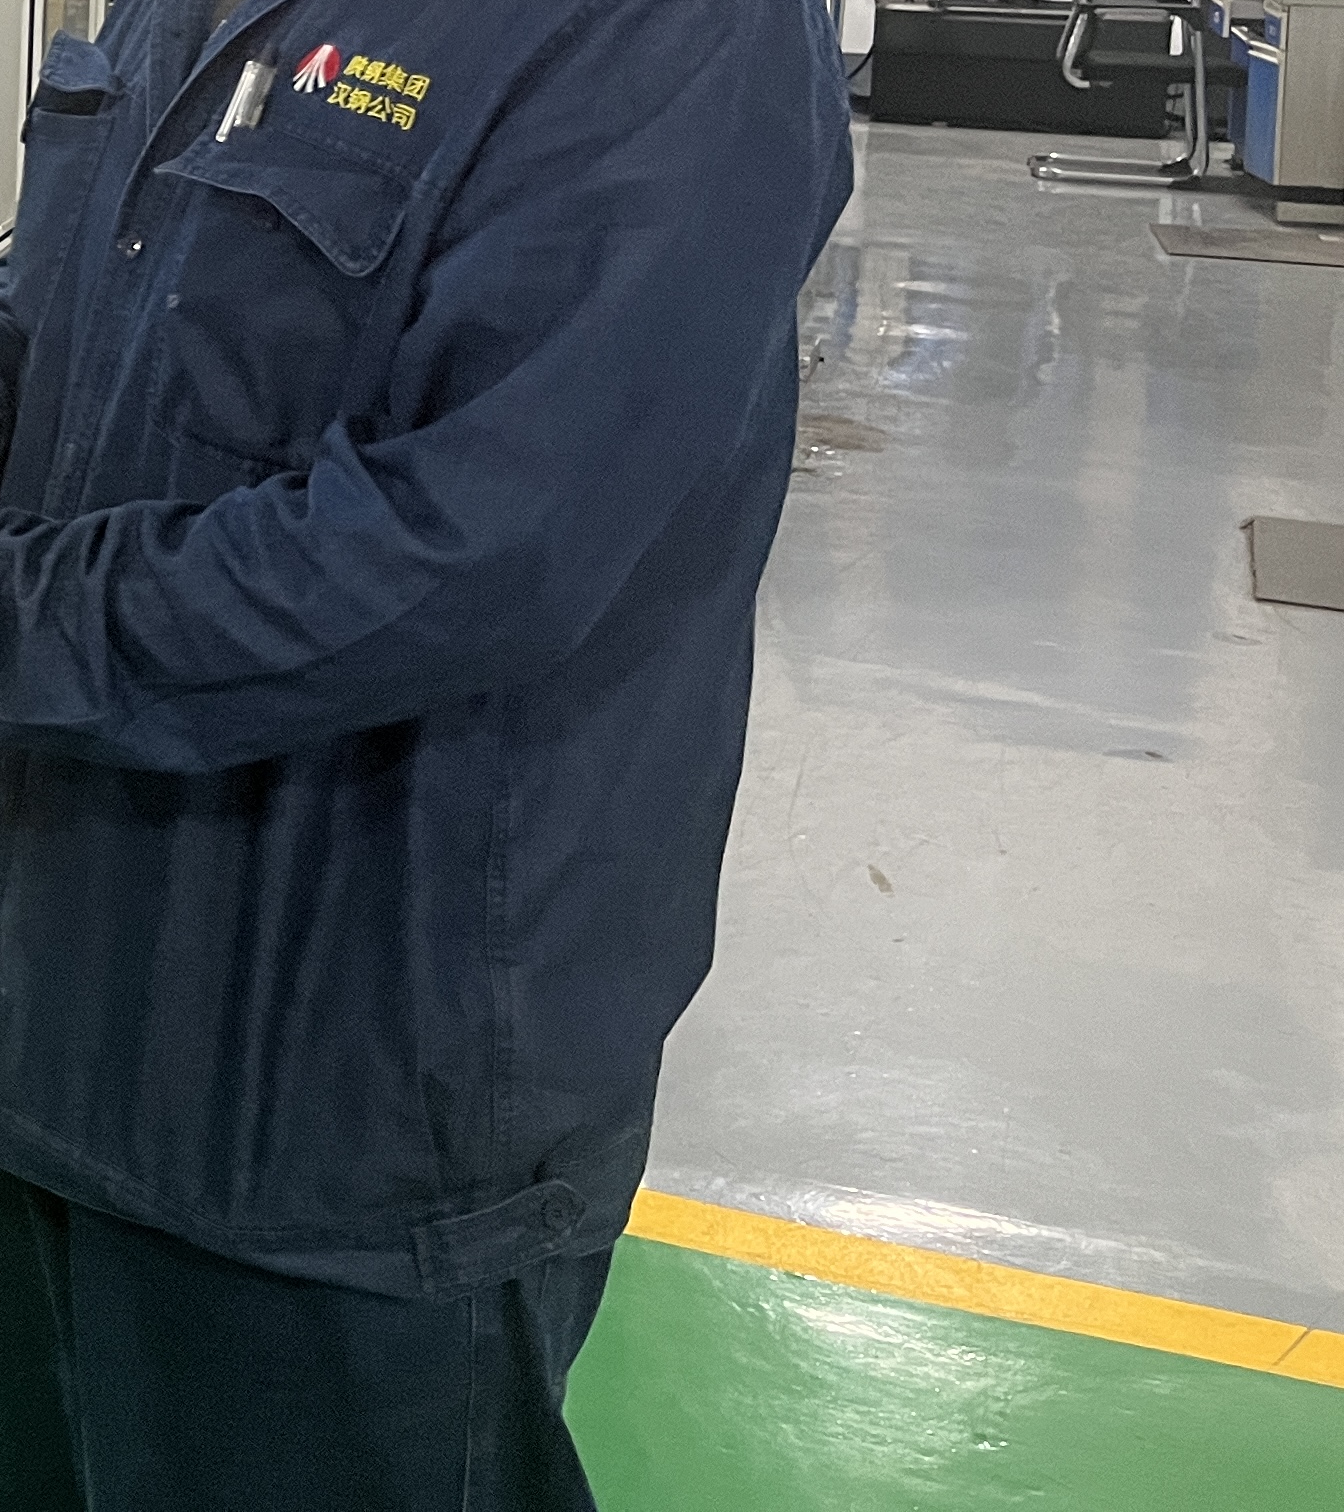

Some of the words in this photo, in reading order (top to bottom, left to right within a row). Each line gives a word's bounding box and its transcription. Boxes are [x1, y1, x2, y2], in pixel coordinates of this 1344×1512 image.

[343, 55, 430, 101] 陕钢集团
[327, 81, 417, 131] 汉钢公司
